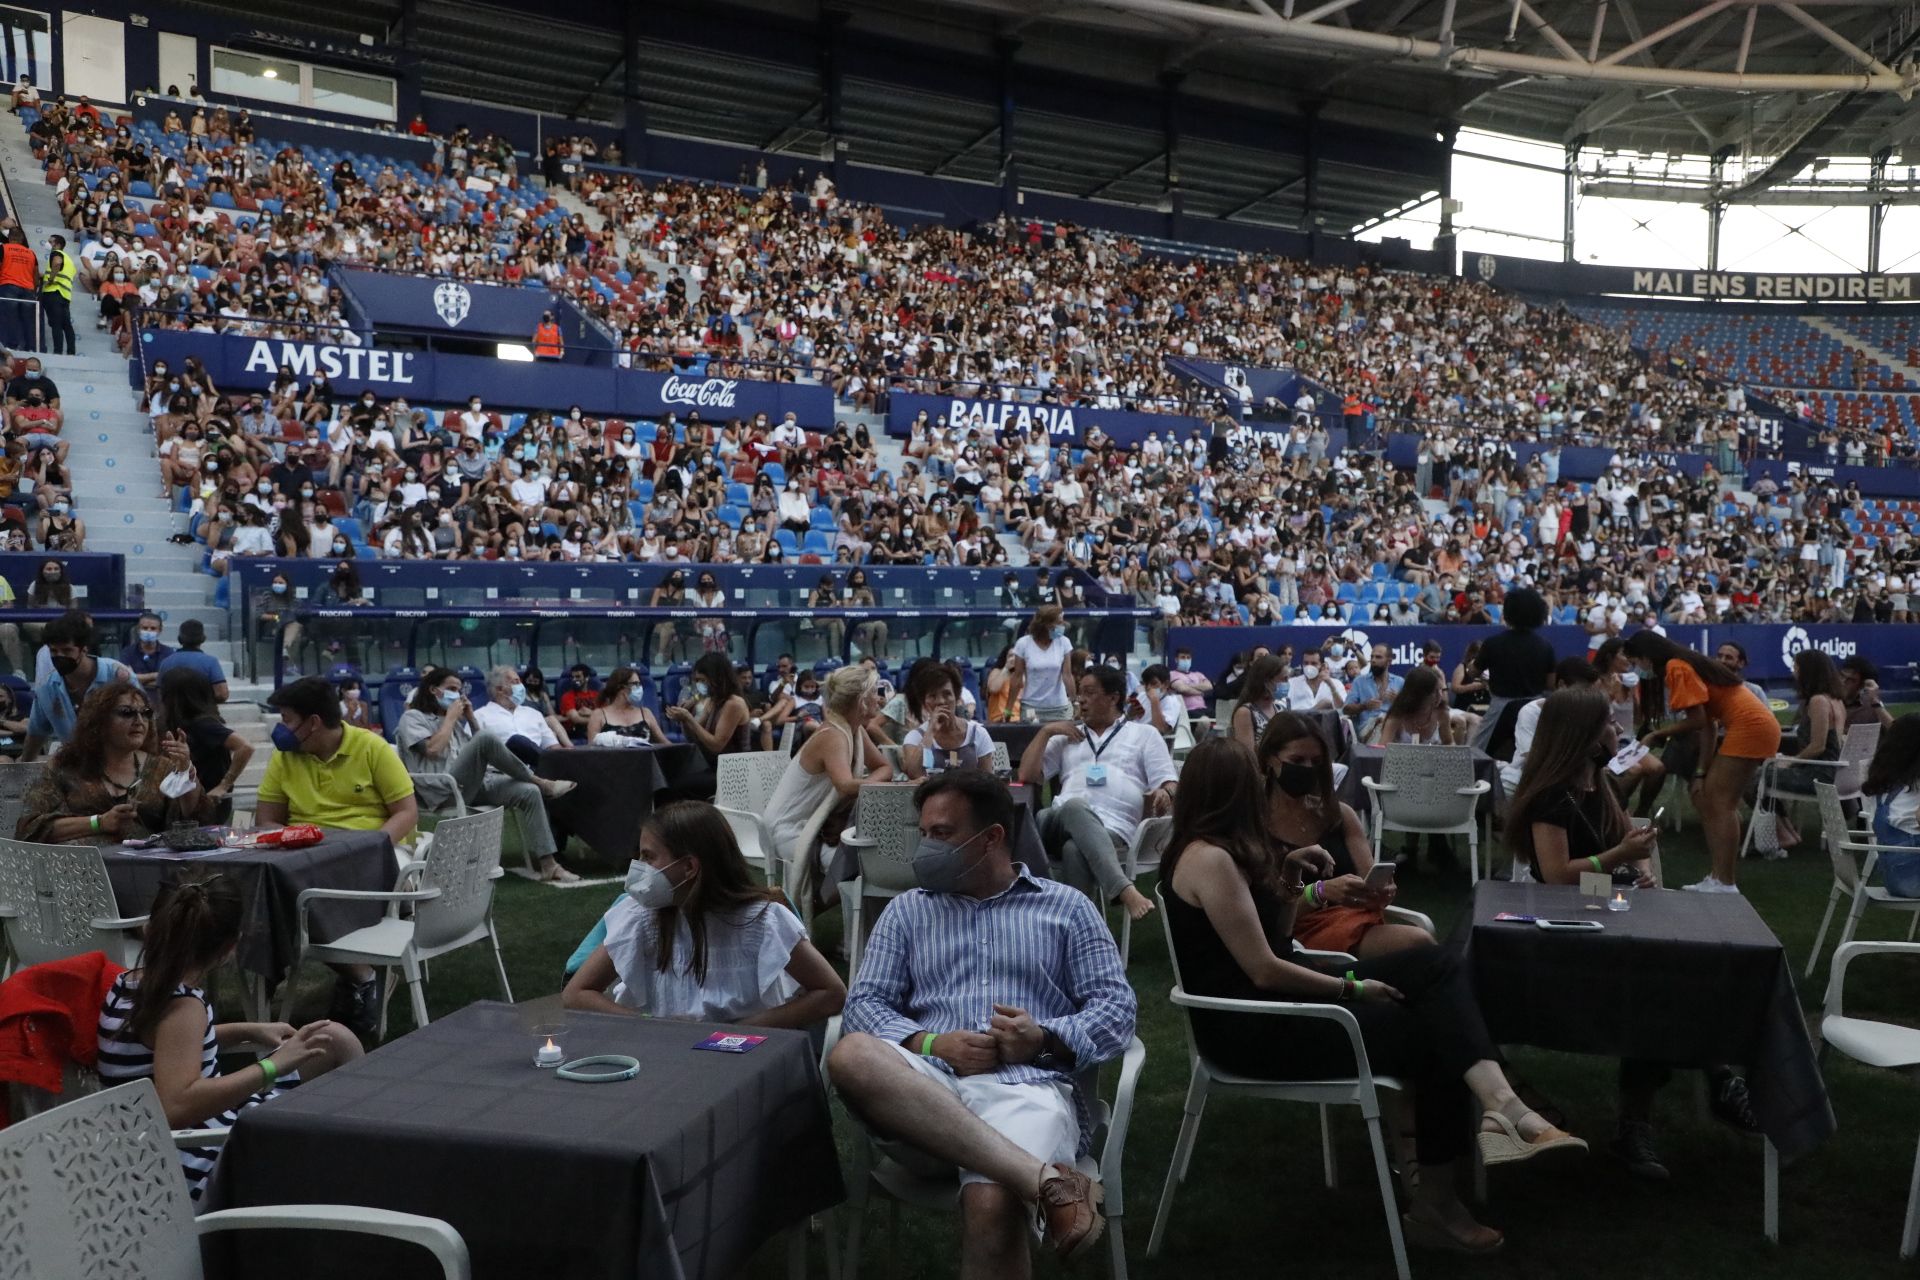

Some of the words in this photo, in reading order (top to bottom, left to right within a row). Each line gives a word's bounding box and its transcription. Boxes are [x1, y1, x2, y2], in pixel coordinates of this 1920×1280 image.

[137, 97, 146, 106] 6
[1633, 271, 1683, 294] MAI
[1693, 274, 1746, 297] ENS
[1756, 276, 1911, 298] RENDIREM
[244, 340, 413, 384] AMSTEL
[319, 610, 352, 618] macron
[396, 610, 427, 618] macron
[469, 610, 499, 618] macron
[540, 610, 569, 618] macron
[607, 610, 635, 618] macron
[671, 610, 697, 618] macron
[731, 610, 757, 618] macron
[789, 610, 813, 618] macron
